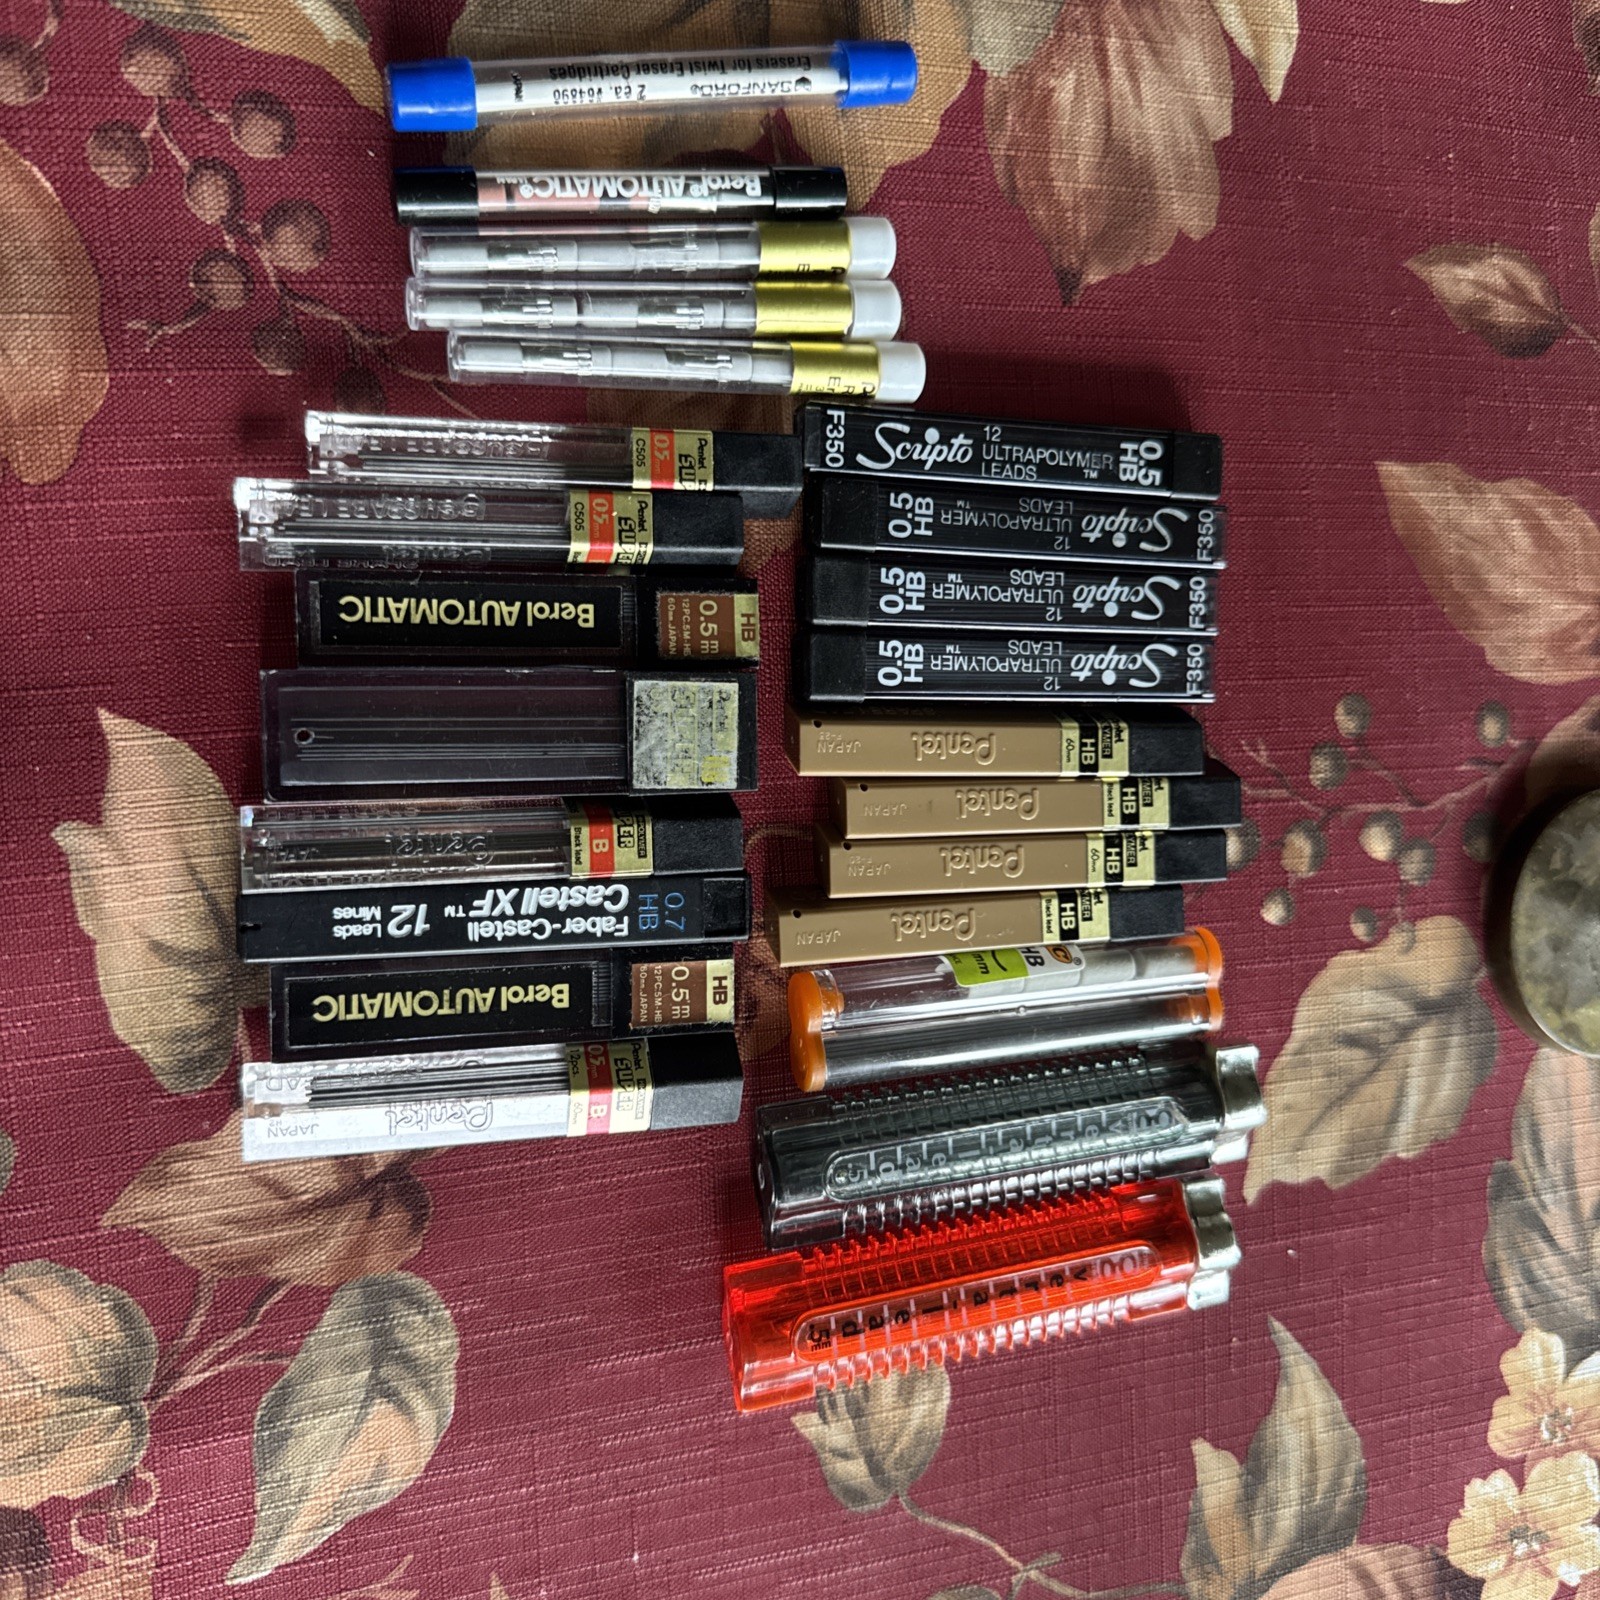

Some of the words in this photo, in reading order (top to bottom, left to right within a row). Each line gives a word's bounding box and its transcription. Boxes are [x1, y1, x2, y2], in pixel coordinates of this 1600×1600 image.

[549, 63, 631, 81] Cartridges
[635, 61, 684, 77] Eraser
[691, 59, 726, 75] Twist
[733, 58, 751, 72] for
[758, 56, 811, 71] Erasers
[636, 84, 647, 100] 2
[825, 408, 846, 467] F350
[855, 422, 975, 471] Scripto
[983, 425, 1001, 442] 12
[635, 437, 646, 468] C505
[698, 437, 709, 470] Pentel
[981, 443, 1114, 471] ULTRAPOLYMER
[1118, 442, 1139, 482] HB
[1137, 440, 1164, 487] 0.5
[679, 453, 697, 491] SUP
[981, 462, 1037, 482] LEADS
[574, 501, 585, 531] C505
[638, 500, 649, 533] Pentel
[888, 492, 914, 539] 0.5
[914, 495, 934, 537] HB
[939, 509, 1073, 533] ULTRAPOLYMER
[1018, 498, 1073, 515] LEADS
[1053, 535, 1071, 551] 12
[1081, 507, 1189, 552] Scripto
[1196, 509, 1215, 562] F350
[879, 566, 905, 615] 0.5
[905, 571, 926, 612] HB
[1010, 569, 1065, 586] LEADS
[932, 582, 1064, 605] ULTRAPOLYMER
[1072, 575, 1181, 621] Scripto
[1188, 575, 1206, 630] F350
[338, 595, 521, 627] AUTOMATIC
[527, 601, 595, 628] Berol
[699, 600, 718, 637] 0.5
[1046, 606, 1063, 622] 12
[740, 612, 756, 642] HB
[1008, 639, 1062, 656] LEADS
[877, 639, 904, 687] 0.5
[903, 643, 924, 683] HB
[930, 654, 1062, 674] ULTRAPOLYMER
[1070, 643, 1178, 688] Scripto
[1186, 643, 1204, 696] F350
[1043, 676, 1061, 691] 12
[817, 740, 862, 754] JAPAN
[911, 730, 997, 766] Pentel
[1065, 738, 1075, 764] 60mm
[1081, 738, 1096, 766] HB
[863, 803, 908, 818] JAPAN
[955, 787, 1040, 821] Pentel
[1106, 803, 1115, 818] lead
[1122, 787, 1137, 815] HB
[574, 827, 583, 848] Black
[592, 838, 610, 854] B
[574, 849, 583, 866] lead
[848, 863, 892, 877] JAPAN
[940, 845, 1025, 878] Pentel
[1090, 847, 1100, 873] 60mm
[1106, 847, 1121, 875] HB
[332, 905, 382, 921] Mines
[468, 888, 515, 918] XF
[519, 884, 630, 916] Castell
[638, 893, 659, 932] HB
[664, 891, 686, 932] 0.7
[1044, 898, 1052, 918] Black
[386, 902, 431, 938] 12
[467, 915, 630, 942] Faber-Castell
[890, 907, 976, 942] Pentel
[1045, 919, 1053, 934] lead
[1060, 902, 1076, 931] HB
[332, 923, 382, 940] Leads
[796, 930, 842, 946] JAPAN
[1021, 946, 1045, 967] HB
[501, 983, 570, 1012] Berol
[671, 966, 690, 1003] 0.5
[712, 975, 729, 1006] HB
[312, 986, 496, 1023] AUTOMATIC
[631, 1042, 644, 1071] Pentel
[614, 1057, 636, 1112] SUPER
[385, 1099, 494, 1137] Pentel
[590, 1104, 608, 1119] B
[266, 1122, 320, 1139] JAPAN
